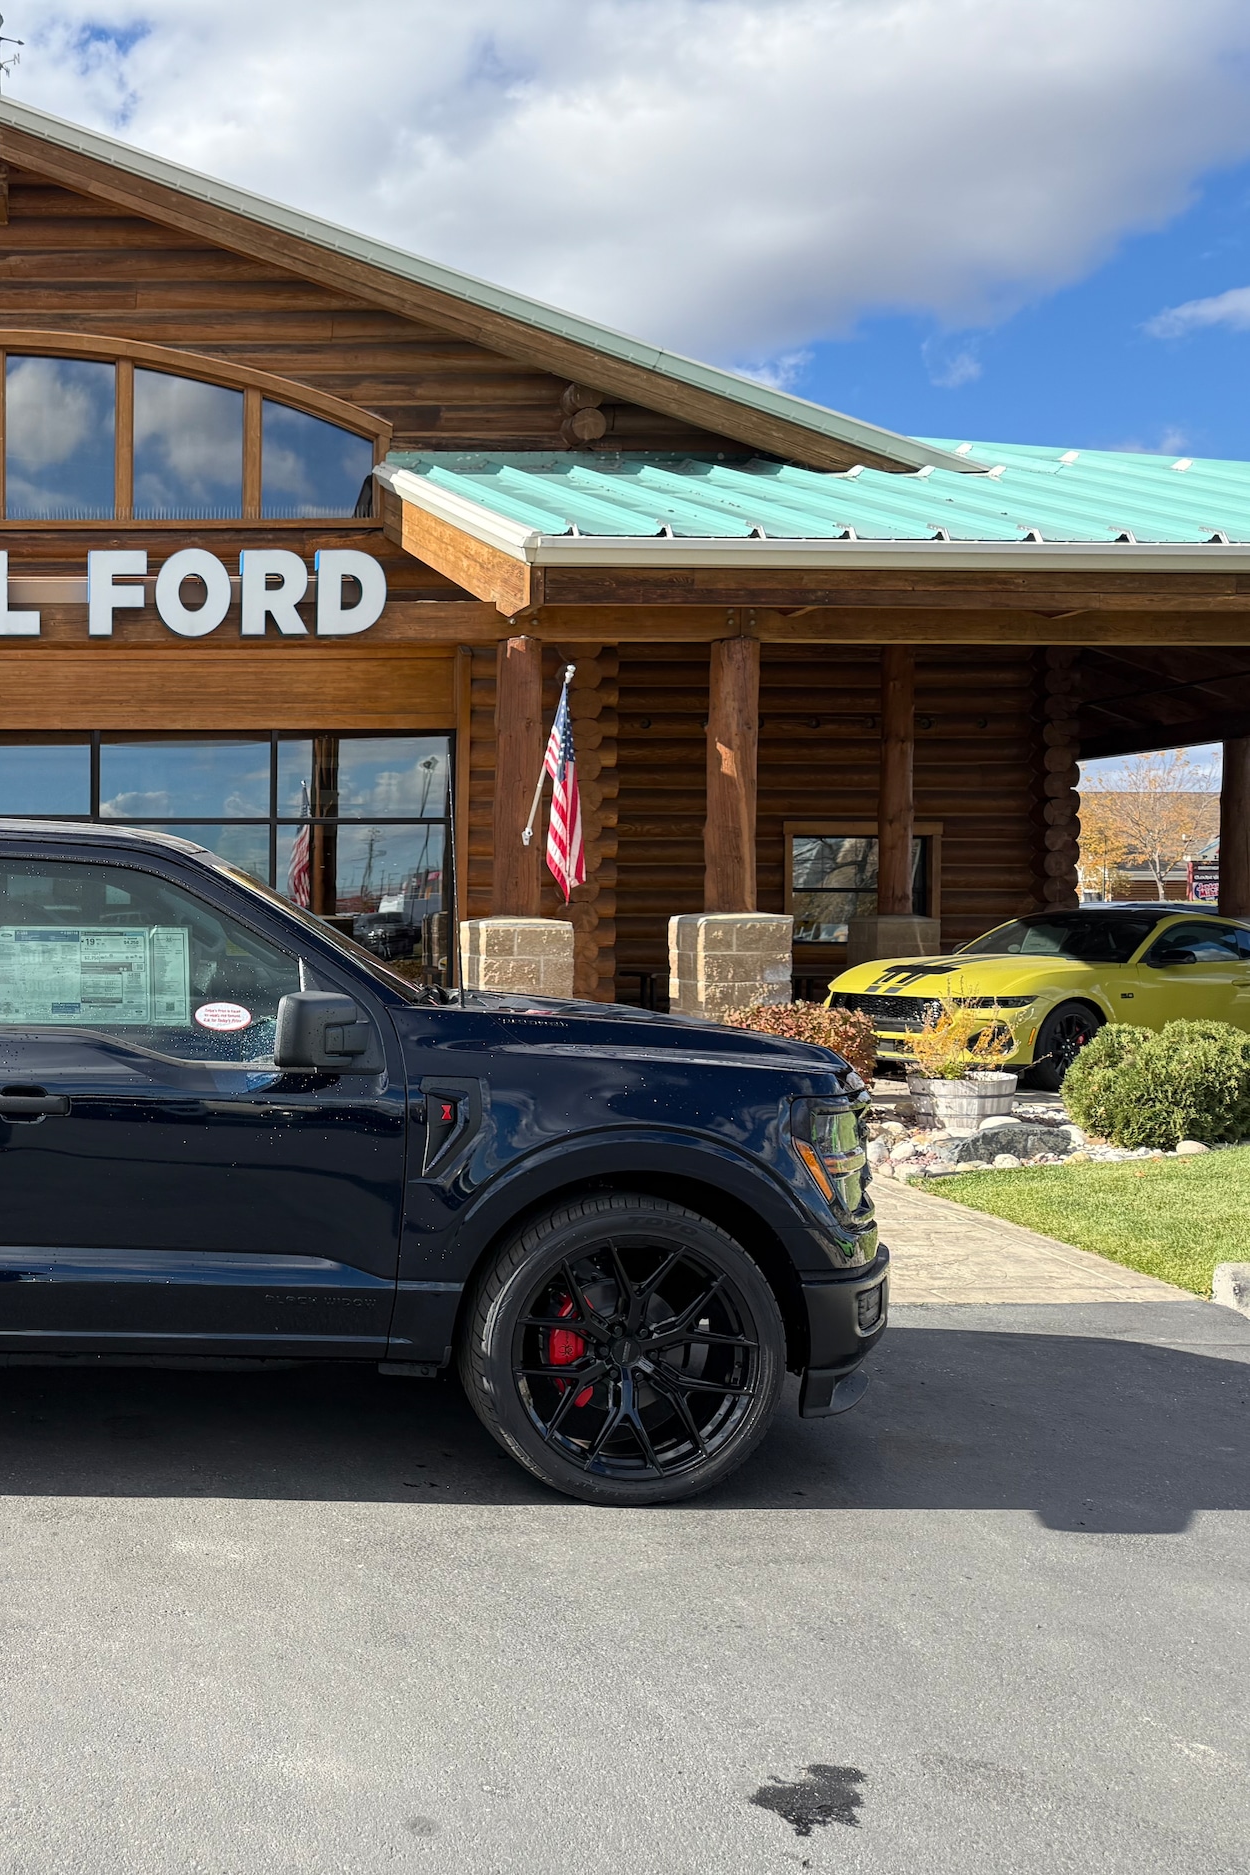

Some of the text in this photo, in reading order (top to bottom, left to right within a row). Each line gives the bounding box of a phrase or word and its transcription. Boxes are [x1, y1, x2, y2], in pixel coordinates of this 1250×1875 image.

[86, 547, 389, 637] FORD
[85, 938, 95, 946] 19
[628, 1216, 698, 1235] TOYO
